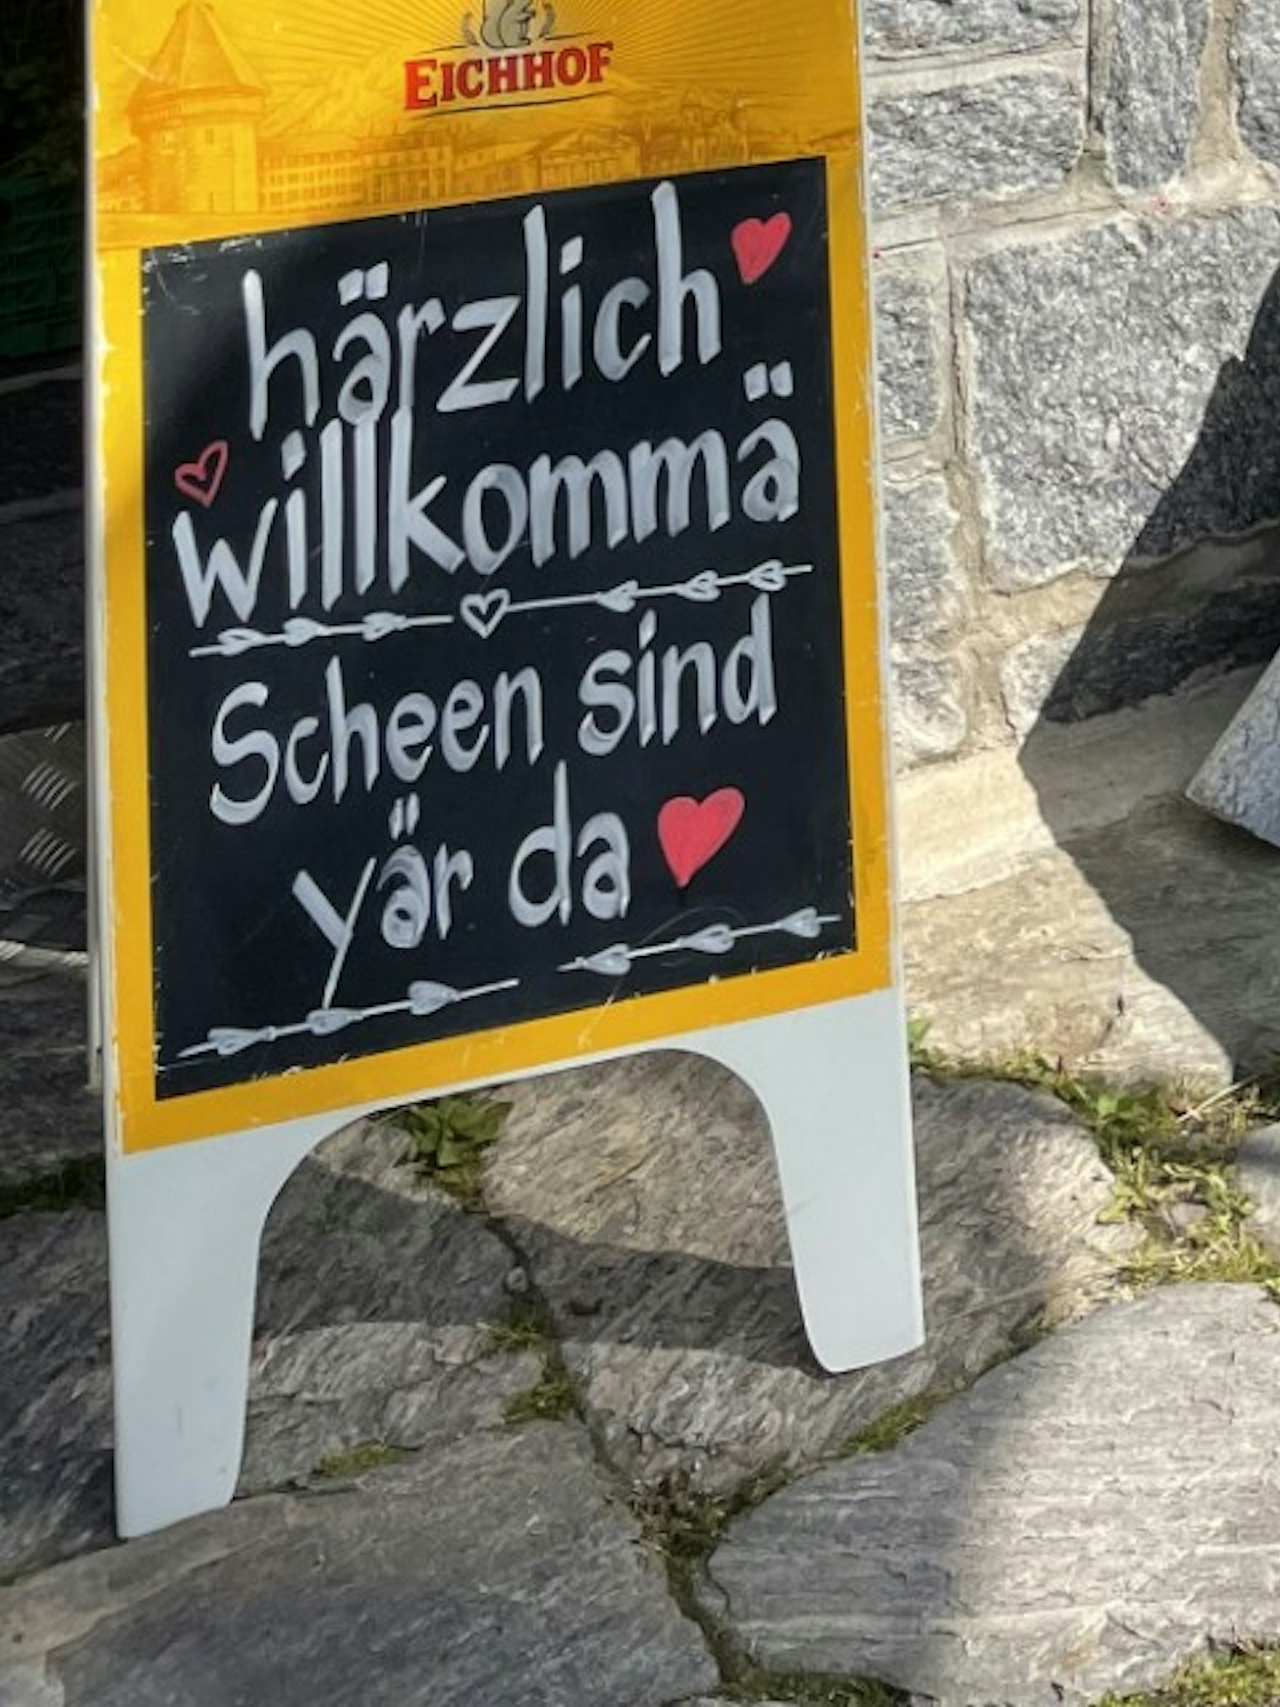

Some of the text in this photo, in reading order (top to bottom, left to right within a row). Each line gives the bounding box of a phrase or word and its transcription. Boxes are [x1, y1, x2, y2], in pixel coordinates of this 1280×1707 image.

[403, 40, 614, 111] EICHHOF
[242, 180, 723, 441] härzlich
[171, 359, 800, 628] willkommä
[209, 593, 776, 825] Scheen sind
[291, 760, 632, 1010] yär da
